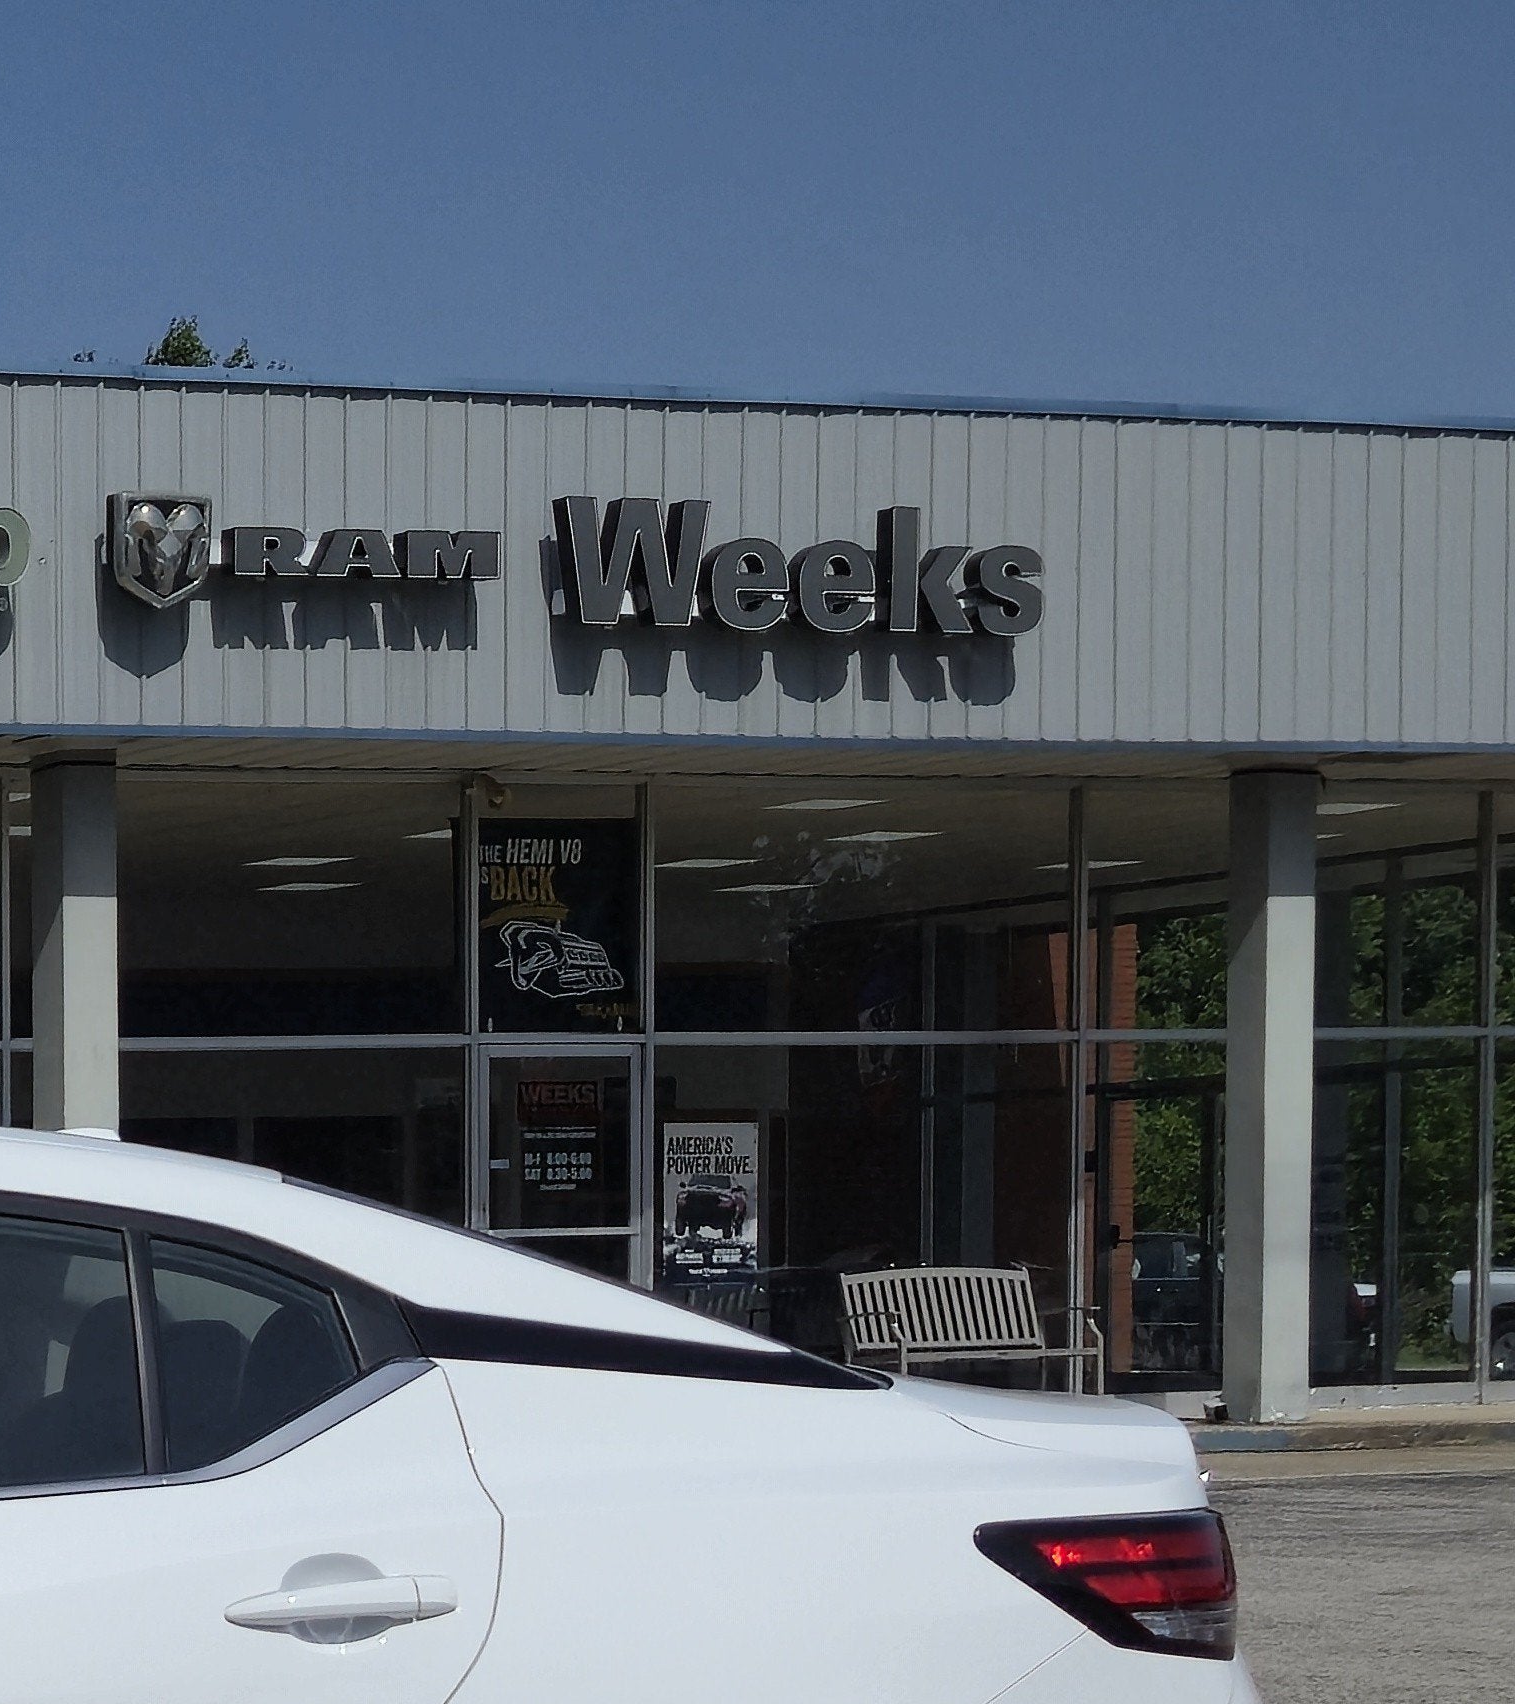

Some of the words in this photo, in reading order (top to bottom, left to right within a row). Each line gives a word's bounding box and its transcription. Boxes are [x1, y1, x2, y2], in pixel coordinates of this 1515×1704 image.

[221, 526, 502, 580] RAM
[552, 494, 1046, 637] Weeks
[506, 838, 554, 864] HEMI
[560, 838, 583, 865] V8
[489, 865, 557, 902] BACK
[520, 1083, 596, 1104] WEEKS
[666, 1136, 734, 1156] AMERICA'S
[666, 1155, 711, 1175] POWER
[714, 1155, 755, 1174] MOVE.
